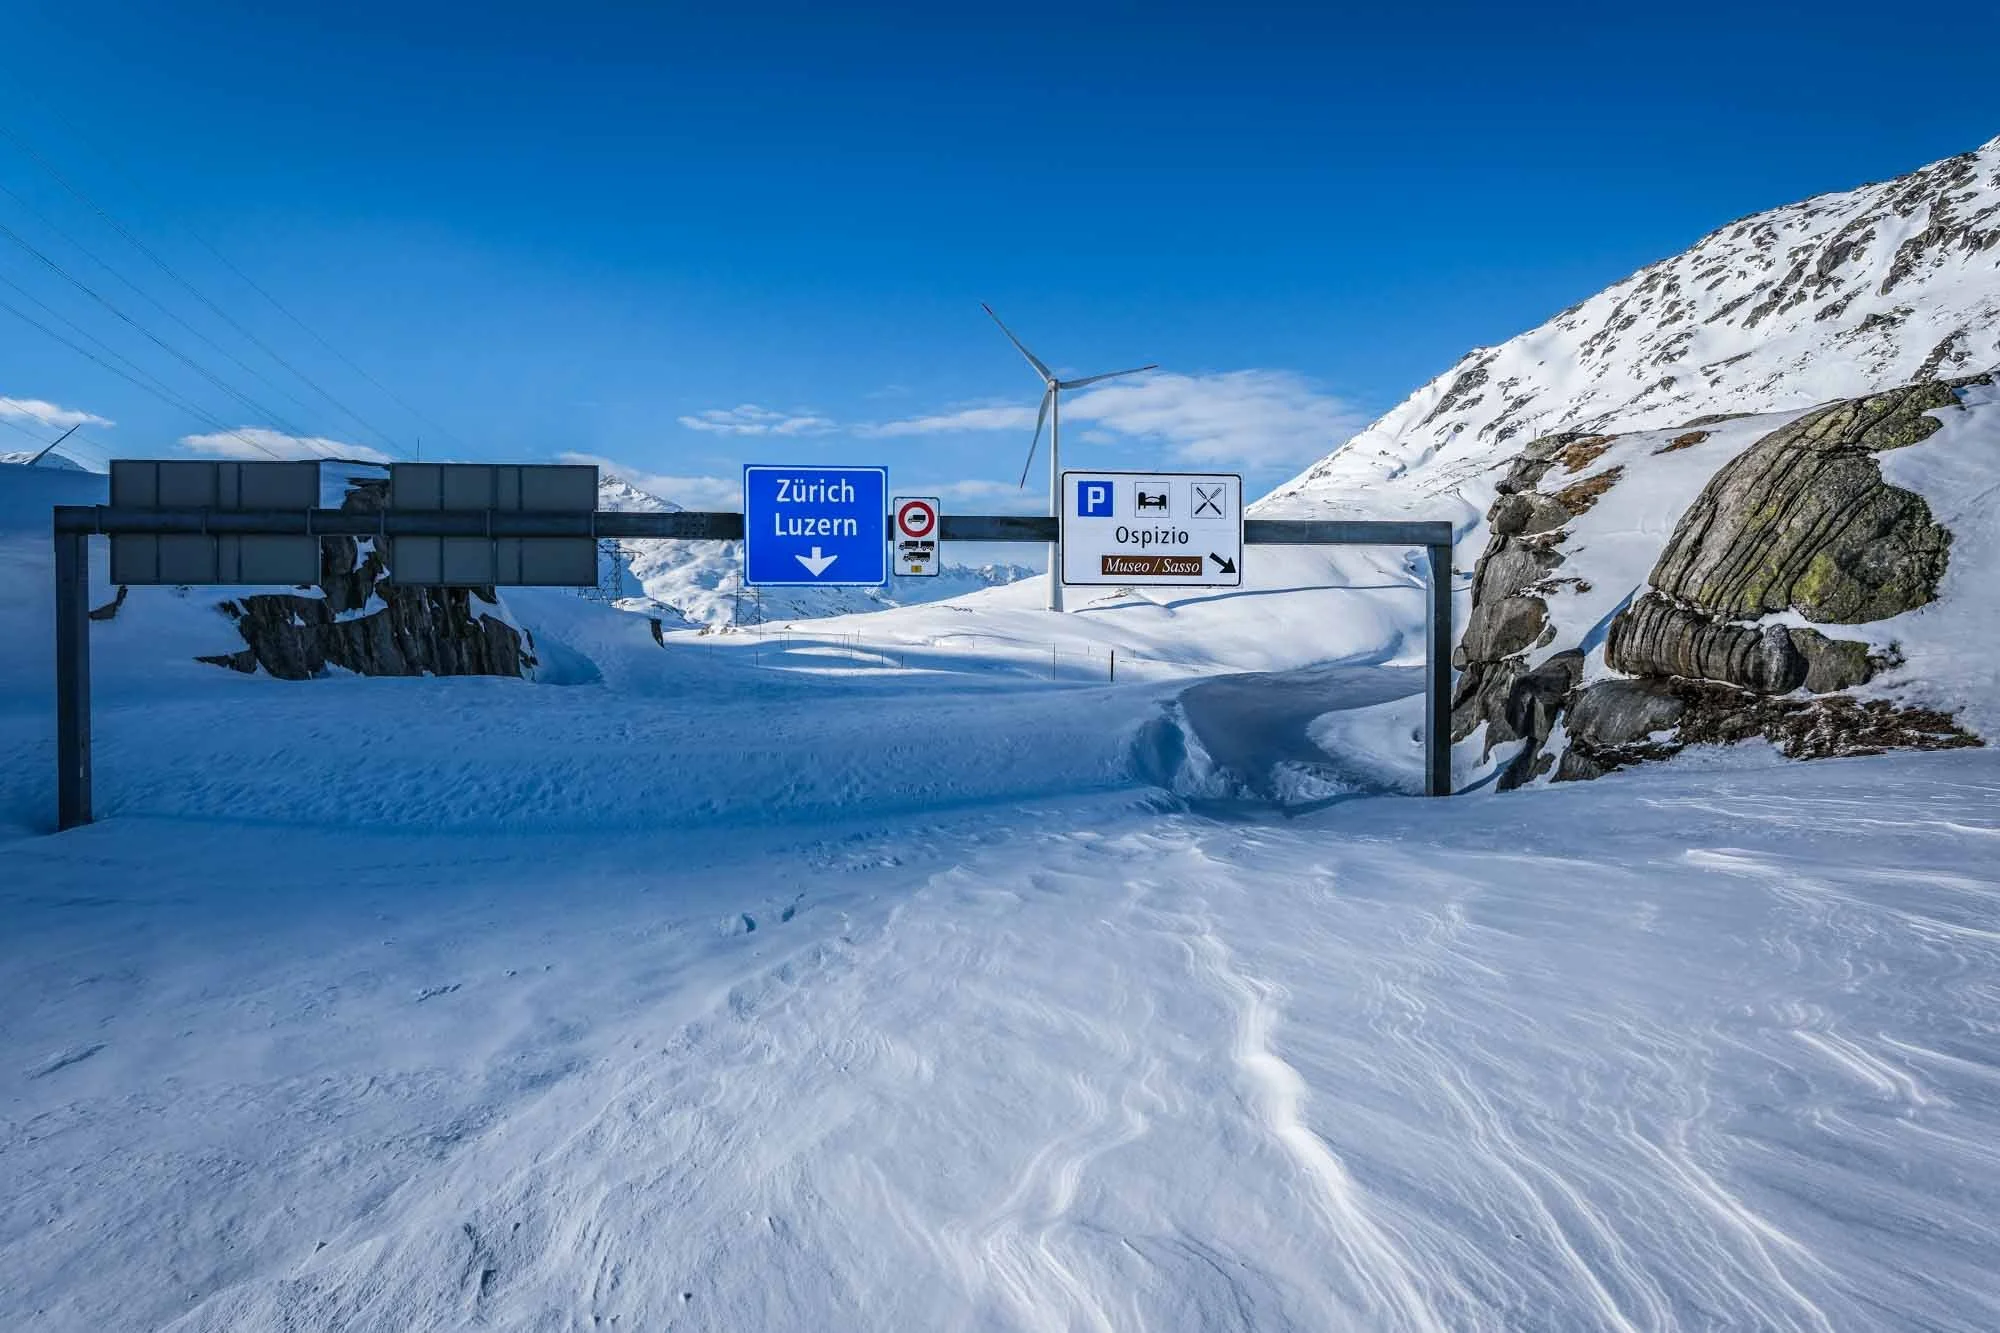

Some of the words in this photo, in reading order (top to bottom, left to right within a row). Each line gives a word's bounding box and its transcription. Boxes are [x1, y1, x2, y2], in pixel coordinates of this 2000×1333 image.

[776, 478, 855, 503] Zürich
[1087, 486, 1106, 513] P
[775, 512, 857, 537] Luzern
[1115, 526, 1189, 548] Ospizio
[1105, 557, 1150, 573] Museo
[1162, 557, 1200, 573] Sasso
